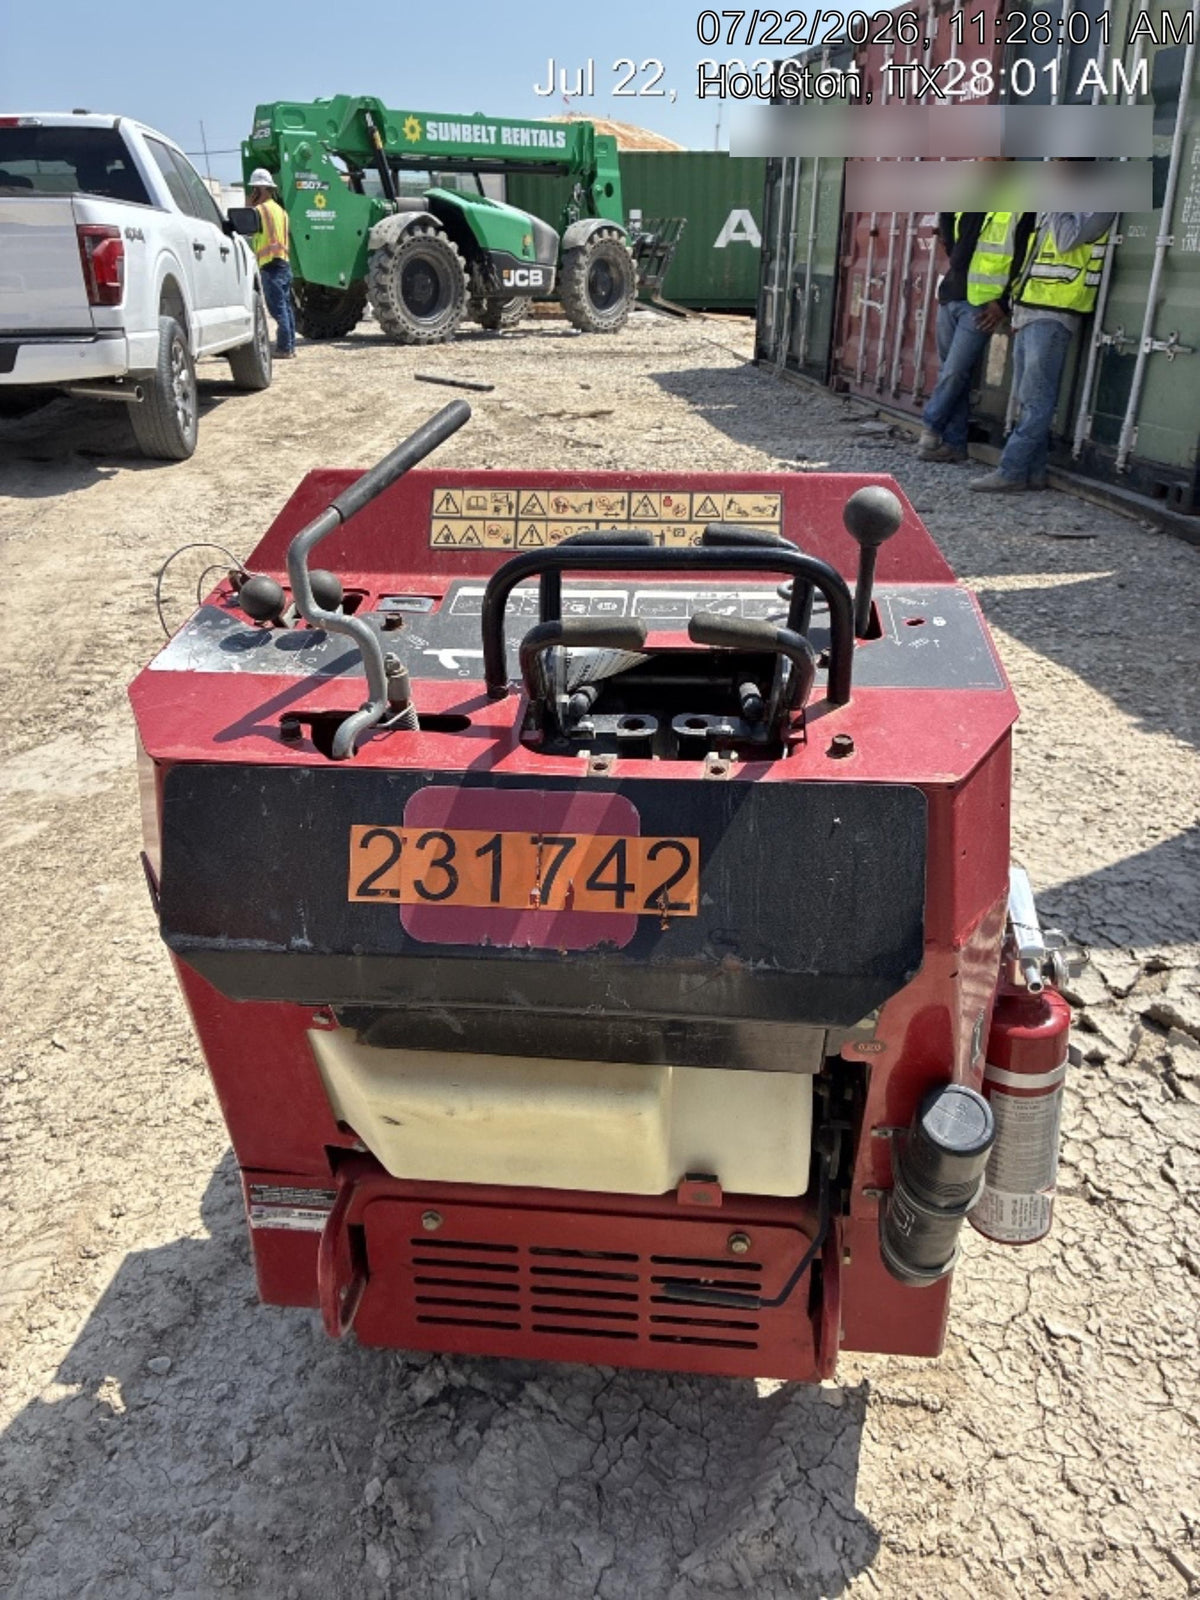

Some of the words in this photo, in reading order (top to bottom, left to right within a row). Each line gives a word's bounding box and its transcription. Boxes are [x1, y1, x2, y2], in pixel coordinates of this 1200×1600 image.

[425, 121, 497, 144] SUNBELT
[501, 127, 566, 148] RENTALS
[502, 269, 543, 287] JCB
[355, 827, 692, 911] 231742
